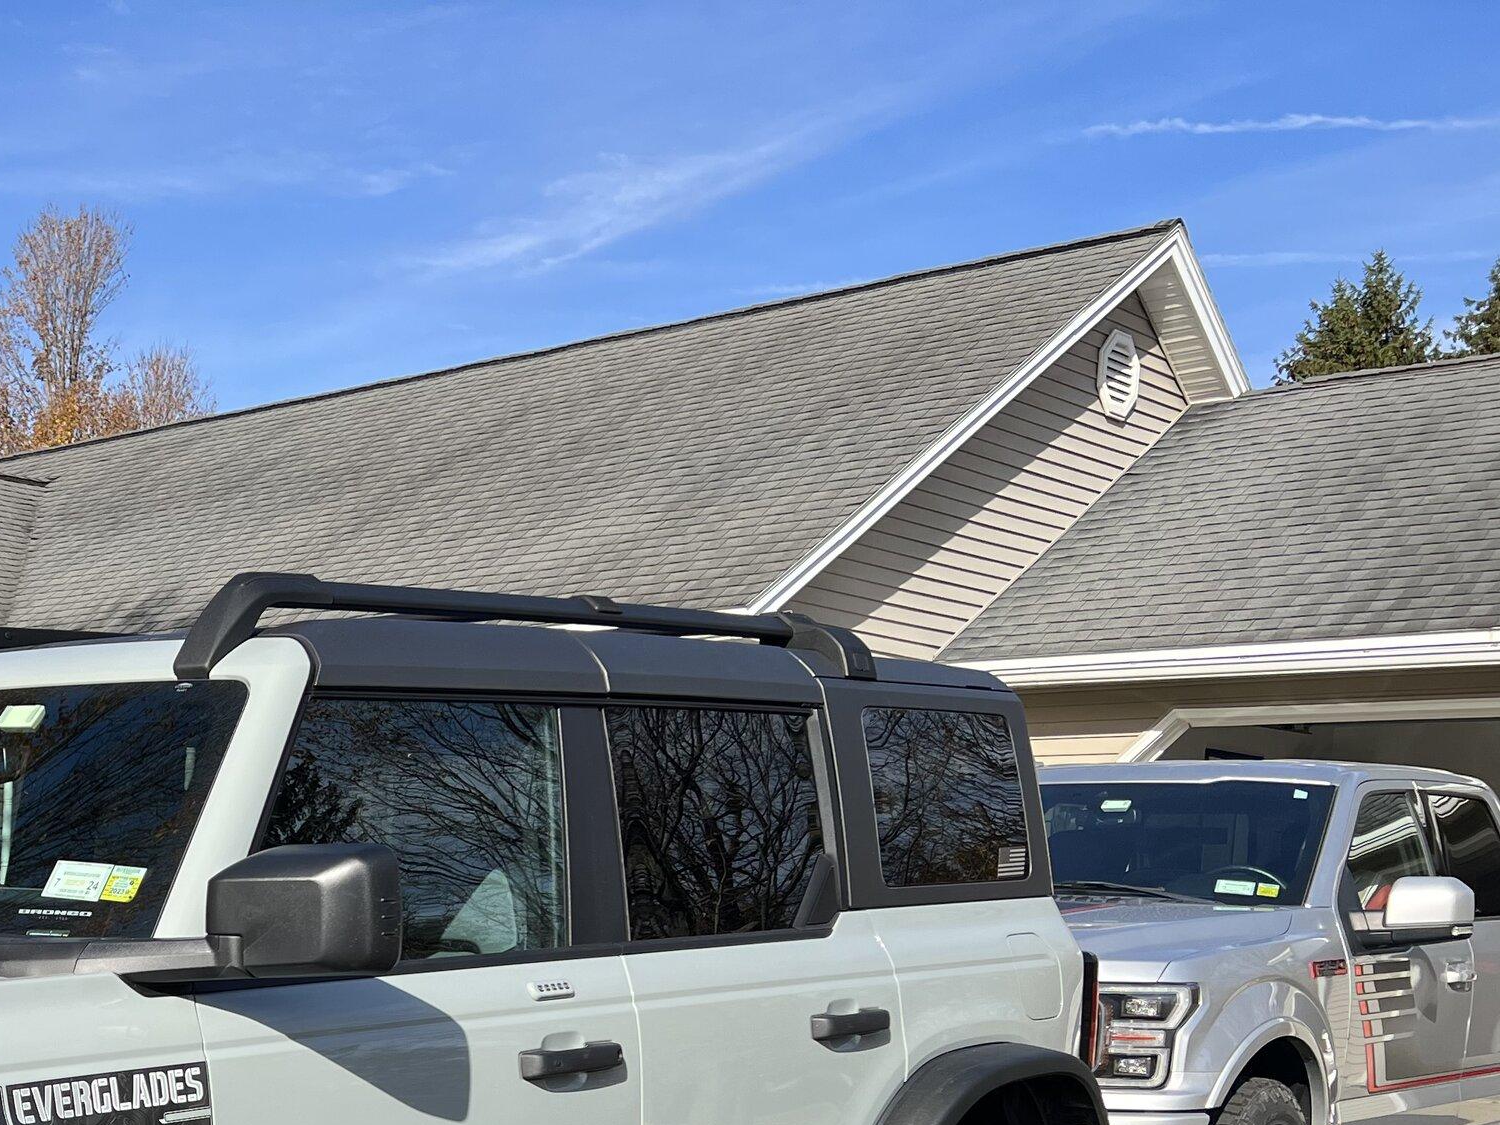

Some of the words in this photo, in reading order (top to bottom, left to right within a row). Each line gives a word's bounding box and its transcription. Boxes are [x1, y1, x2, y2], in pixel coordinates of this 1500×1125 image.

[87, 881, 100, 891] 24
[18, 908, 92, 916] BRONCO
[12, 1067, 204, 1125] EVERGLADES
